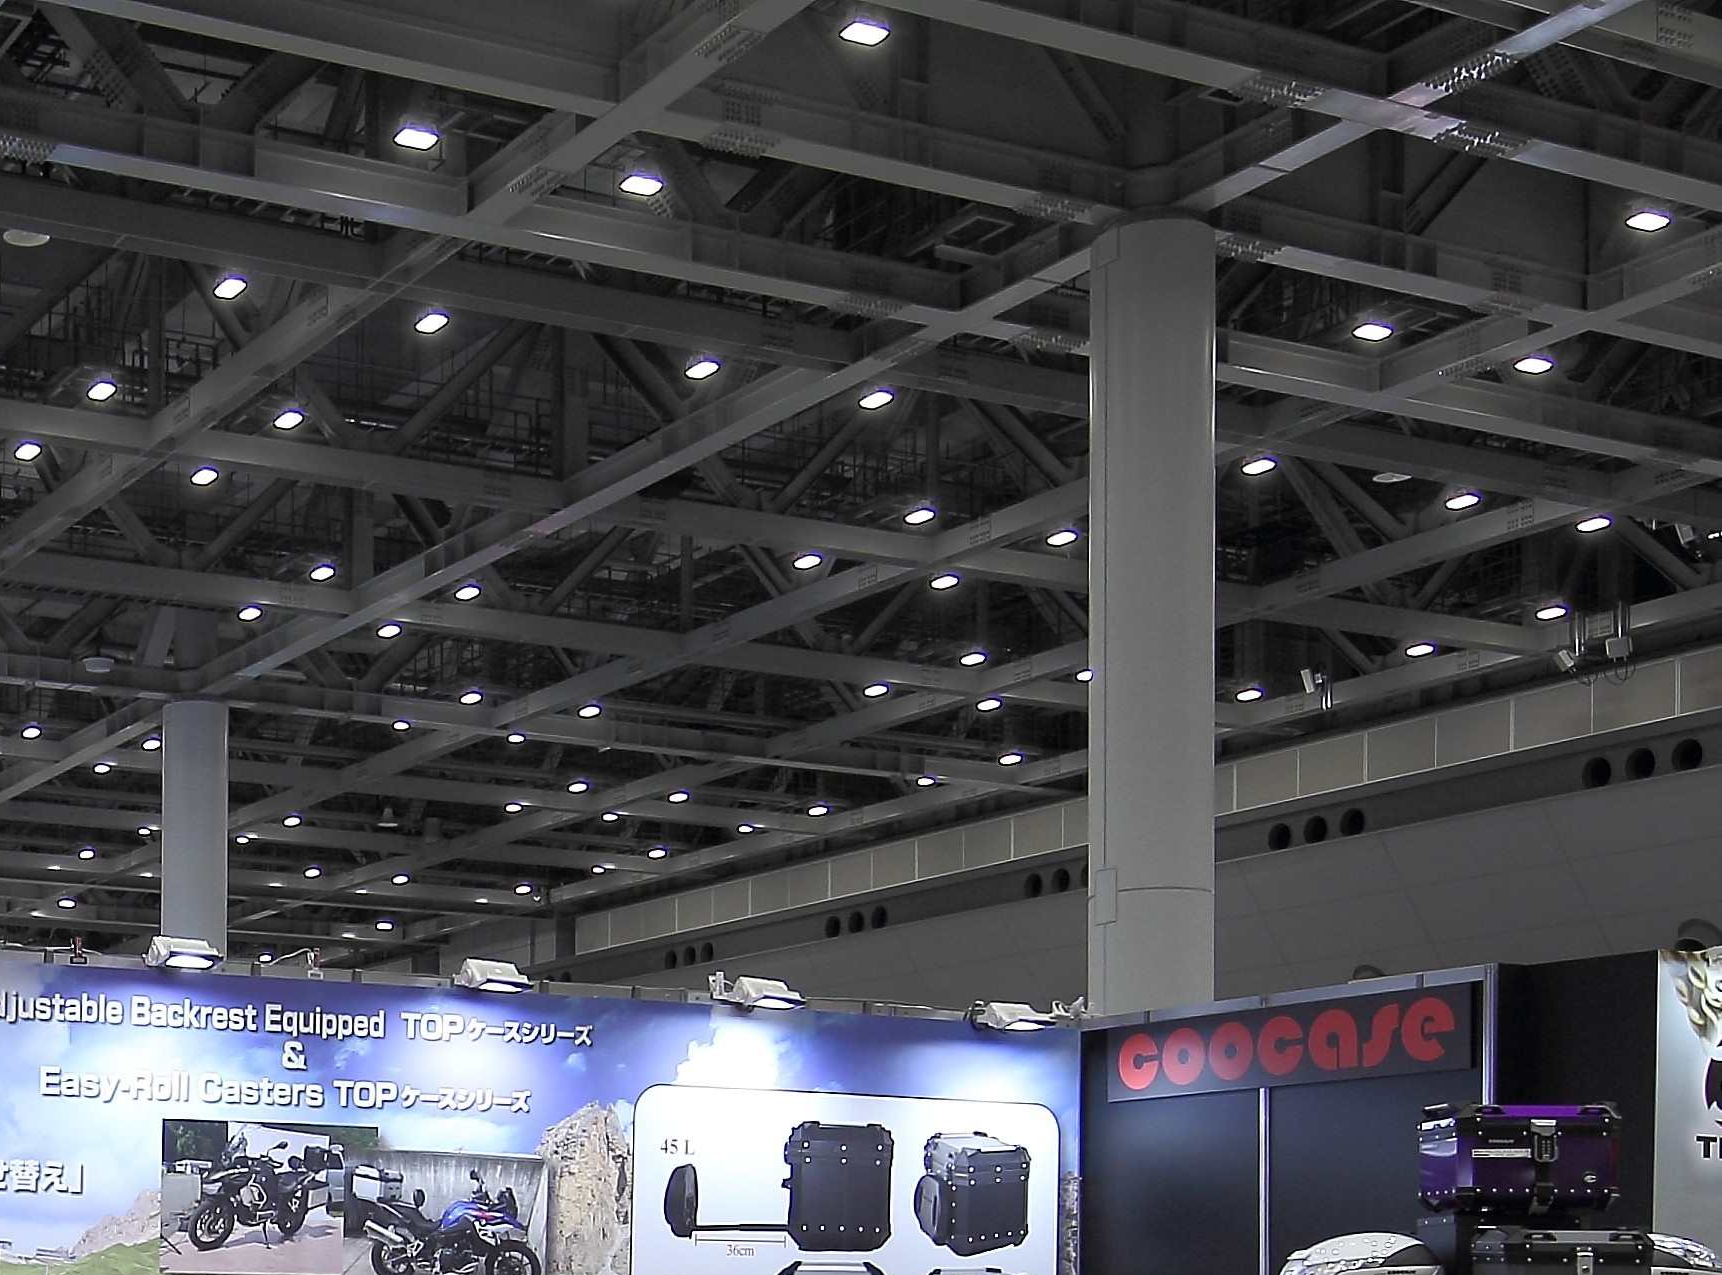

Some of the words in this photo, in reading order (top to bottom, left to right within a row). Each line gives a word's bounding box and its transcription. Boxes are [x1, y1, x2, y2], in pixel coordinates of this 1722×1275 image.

[131, 995, 258, 1031] Backrest
[265, 1003, 385, 1040] Equipped
[401, 1012, 593, 1047] TOPケースシリーズ
[281, 1041, 308, 1070] &
[39, 1065, 189, 1103] Easy-Roll
[197, 1072, 325, 1107] Casters
[333, 1080, 531, 1113] TOPケースシリーズ
[660, 1138, 679, 1155] 45
[684, 1139, 695, 1155] L
[1695, 1135, 1722, 1160] T
[725, 1244, 755, 1257] 36cm
